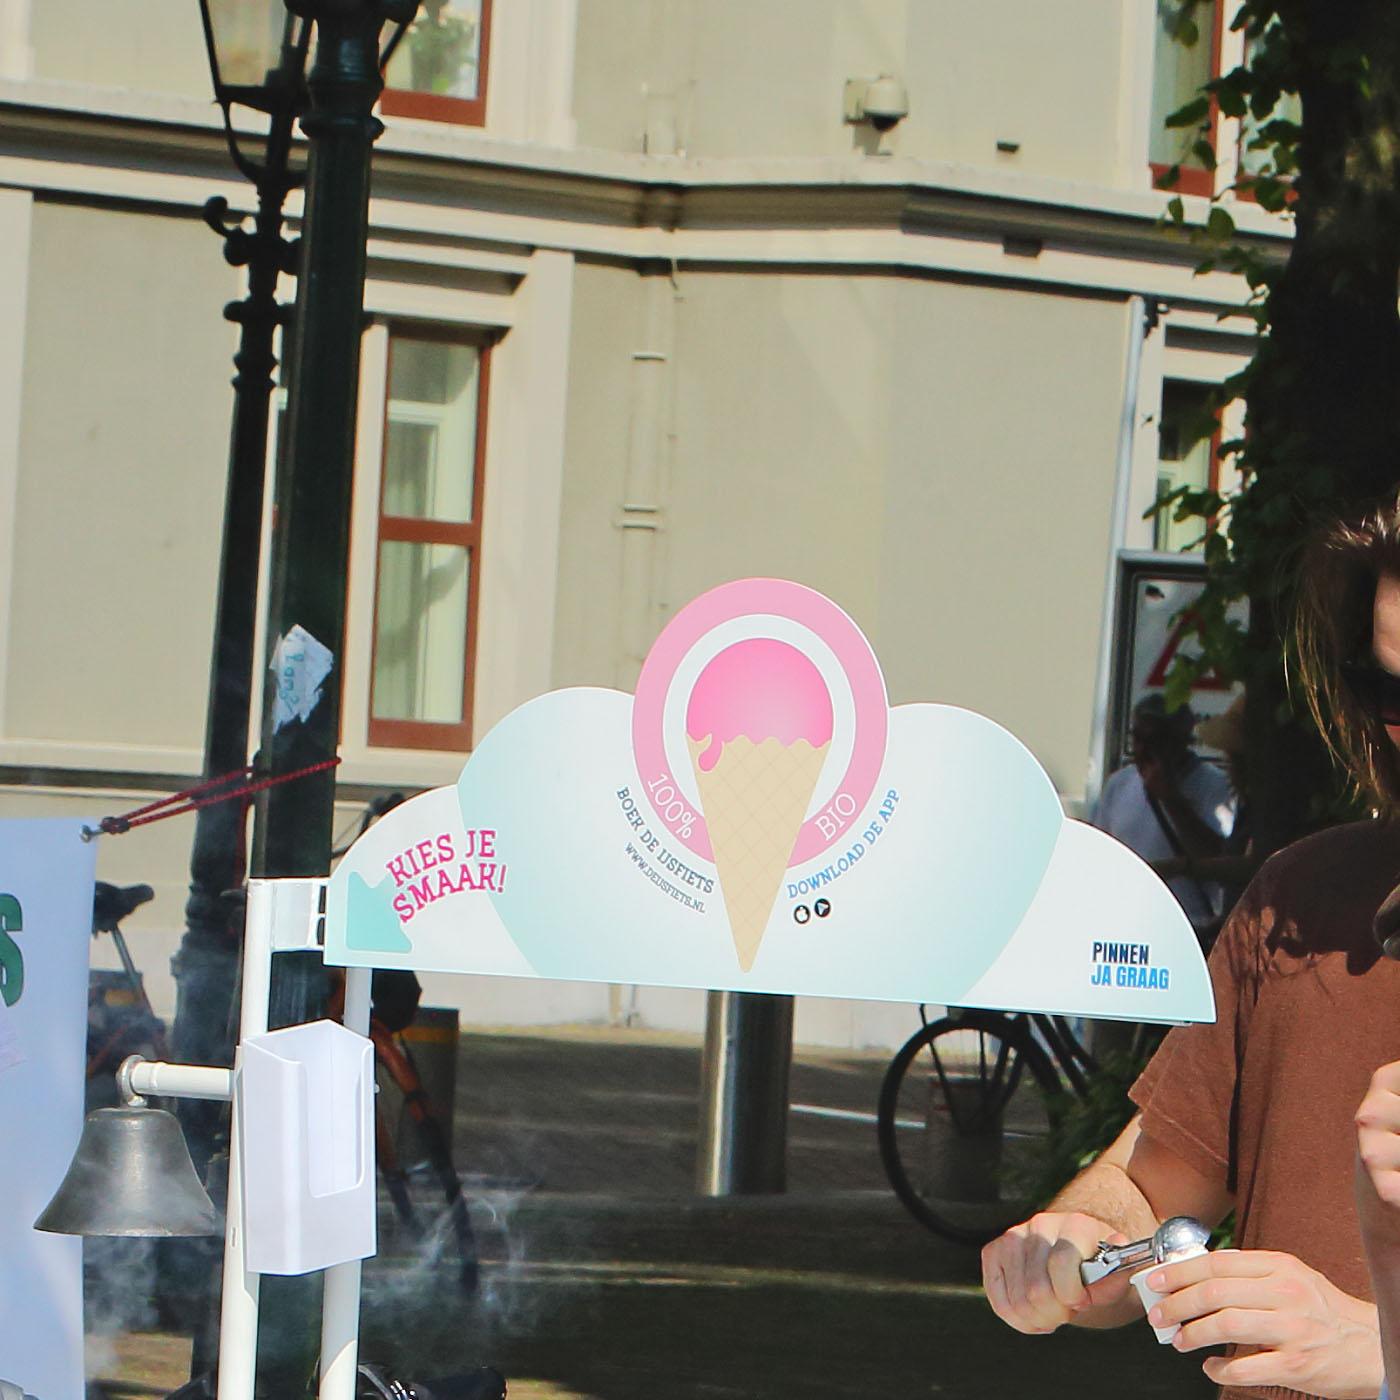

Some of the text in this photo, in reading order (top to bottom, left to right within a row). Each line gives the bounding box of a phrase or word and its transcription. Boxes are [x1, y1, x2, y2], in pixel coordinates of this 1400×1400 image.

[648, 773, 697, 839] 100%
[814, 793, 857, 841] BIO
[386, 829, 496, 887] KIES JE
[640, 829, 660, 853] DE
[787, 789, 900, 899] DOWNLOAD DE APP
[393, 863, 507, 923] SMAAK!
[1091, 964, 1170, 990] JA GRAAG
[1092, 941, 1150, 965] PINNEN
